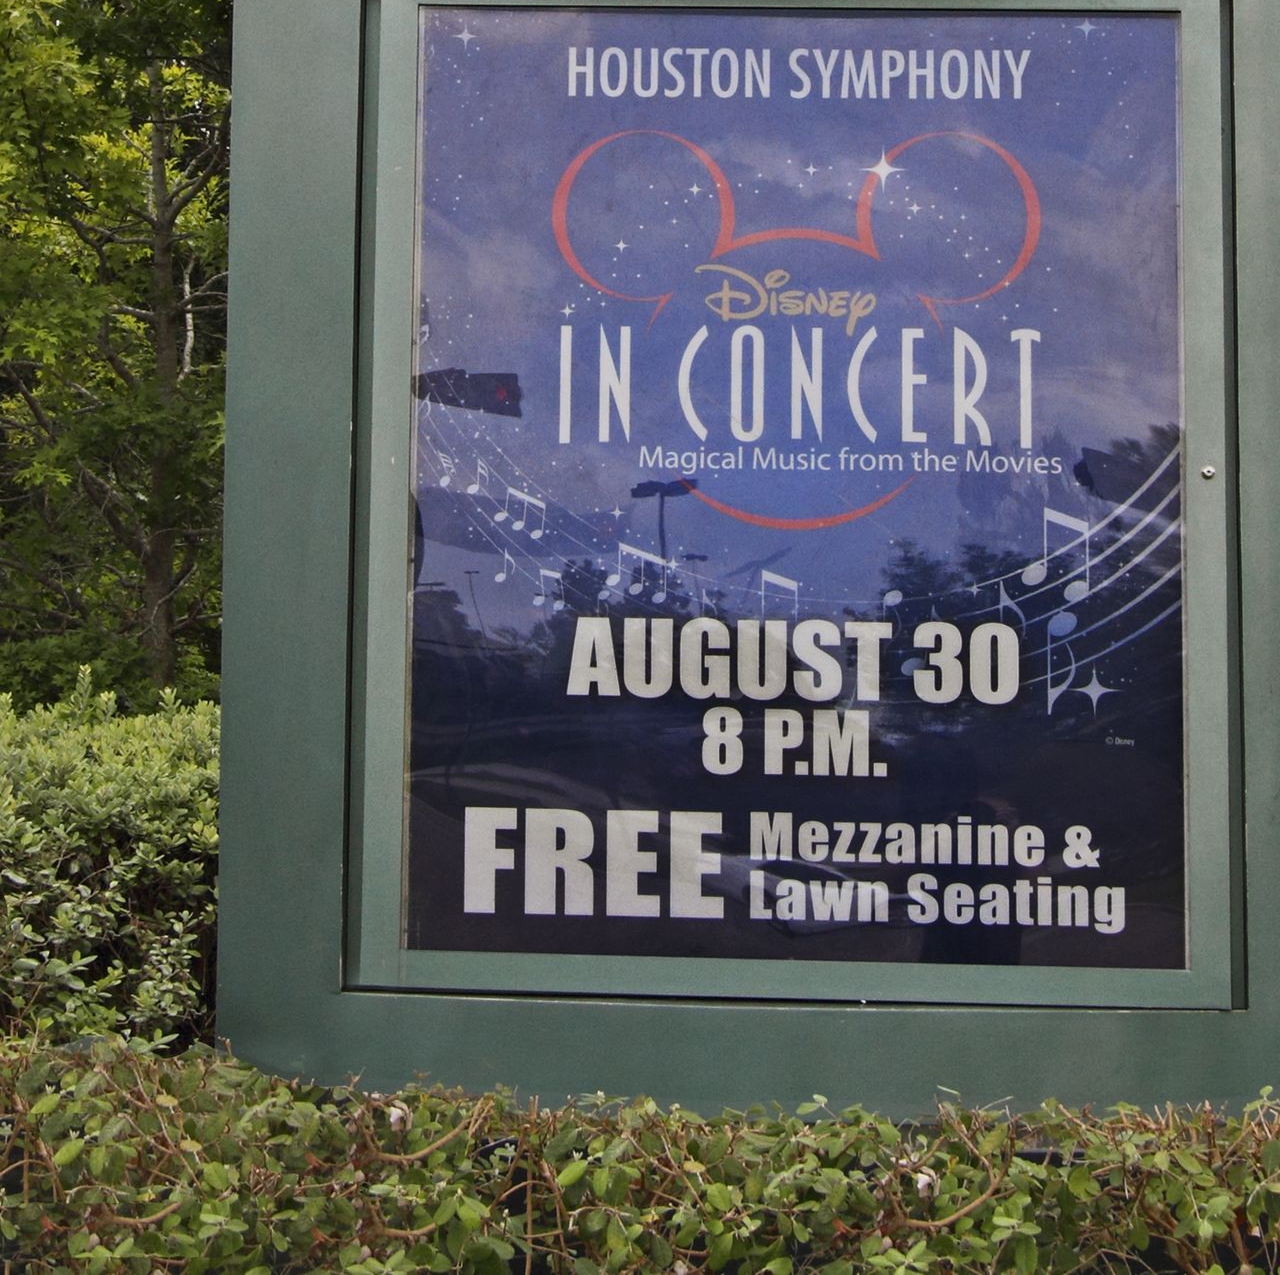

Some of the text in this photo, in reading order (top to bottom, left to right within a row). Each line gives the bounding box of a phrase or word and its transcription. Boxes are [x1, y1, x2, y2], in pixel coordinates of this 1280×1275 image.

[567, 45, 1032, 101] HOUSTON SYMPHONY
[558, 324, 1042, 449] IN CONCERT
[638, 445, 1063, 475] Magical Music from the Movies
[566, 616, 1021, 706] AUGUST 30
[701, 706, 888, 778] 8 P.M.
[463, 806, 724, 919] FREE
[749, 811, 1101, 869] Mezzanine &
[749, 870, 1126, 934] Lawn Seating
